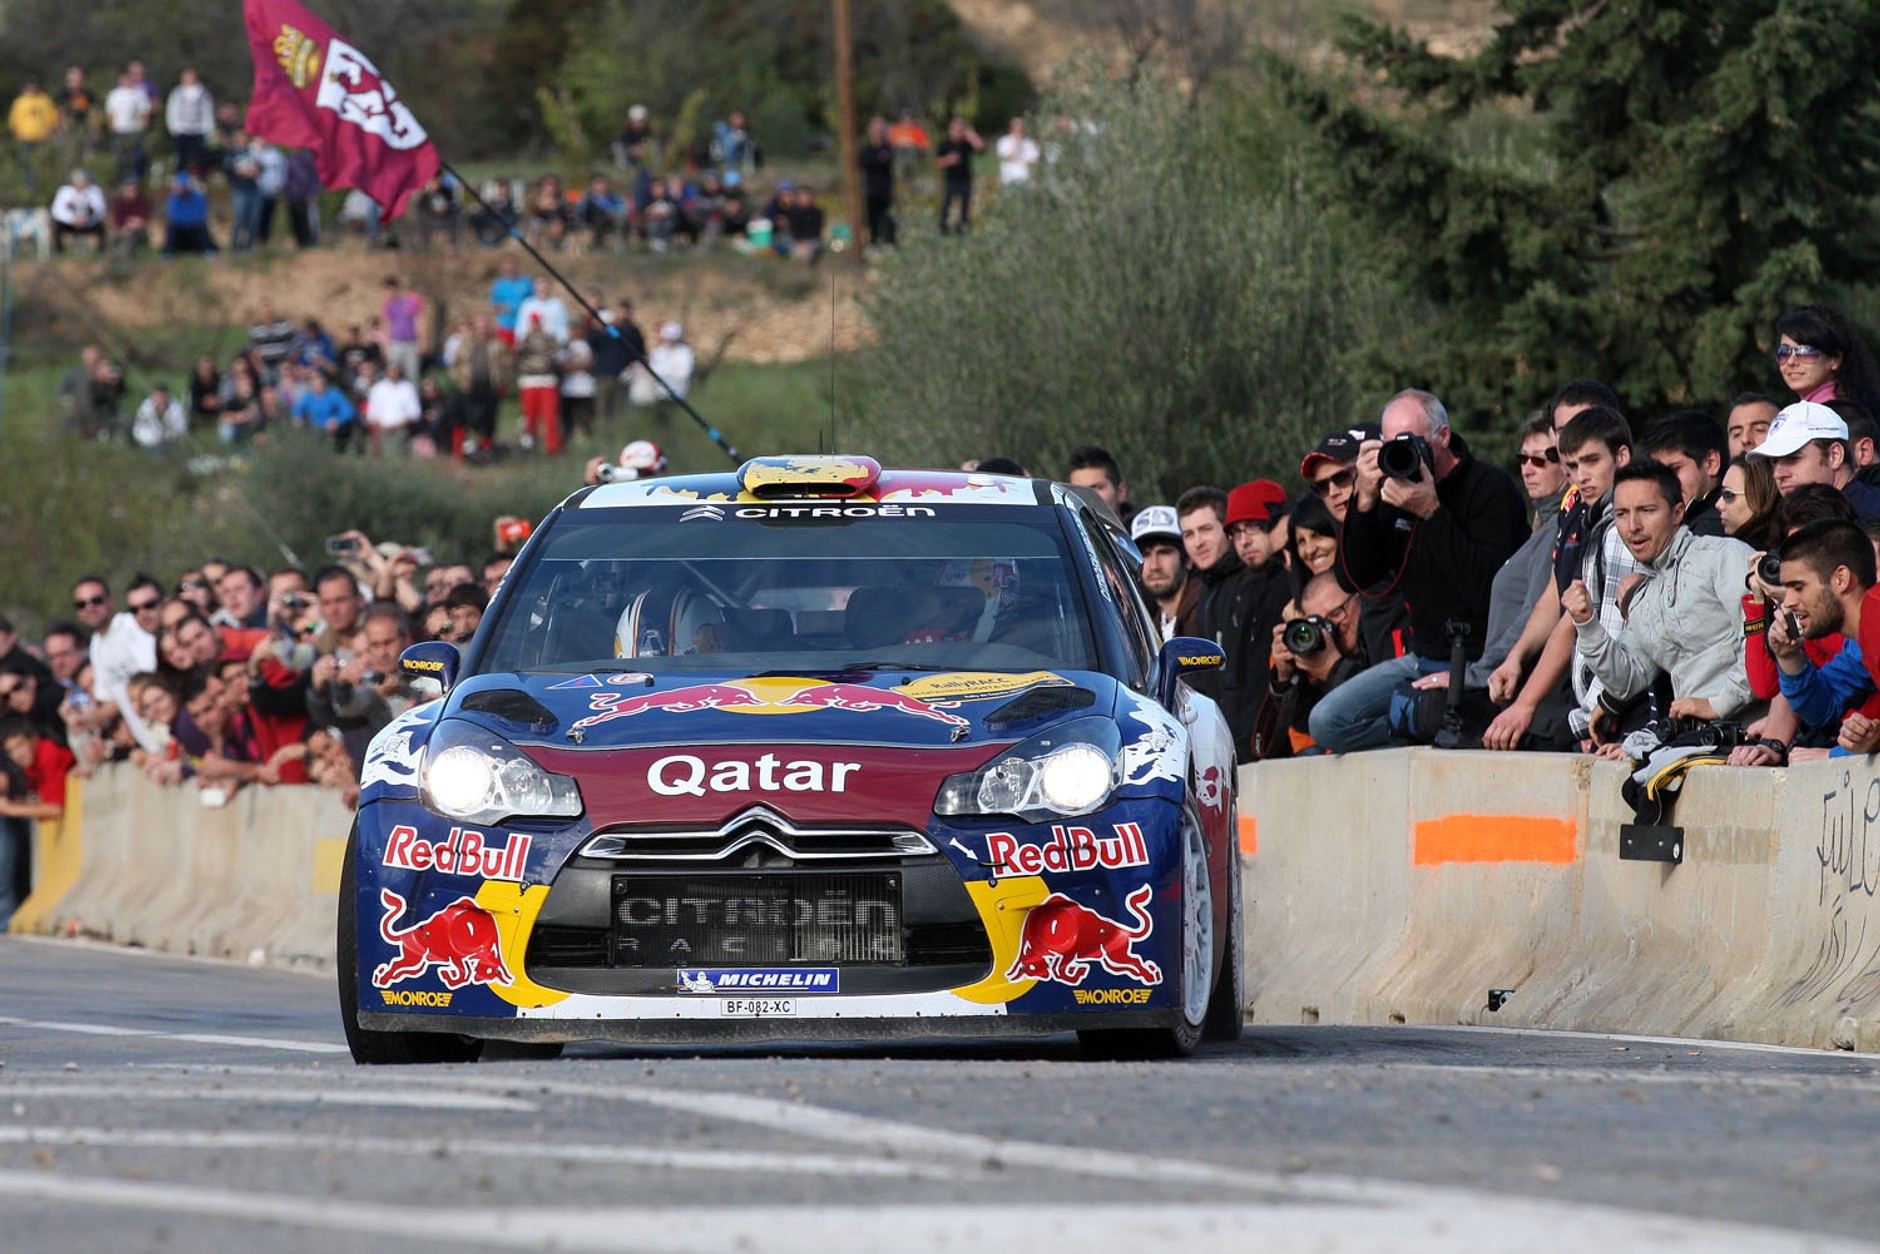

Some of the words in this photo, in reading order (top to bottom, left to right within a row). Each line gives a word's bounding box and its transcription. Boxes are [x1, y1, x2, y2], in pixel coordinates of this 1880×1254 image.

[405, 659, 442, 671] MONROE
[1182, 656, 1217, 665] MONROE
[647, 752, 862, 797] Qatar
[718, 973, 831, 986] MICHELIN
[388, 993, 446, 1007] MONROE
[1080, 989, 1144, 1004] MONROE
[727, 1001, 791, 1013] BF-082-XC
